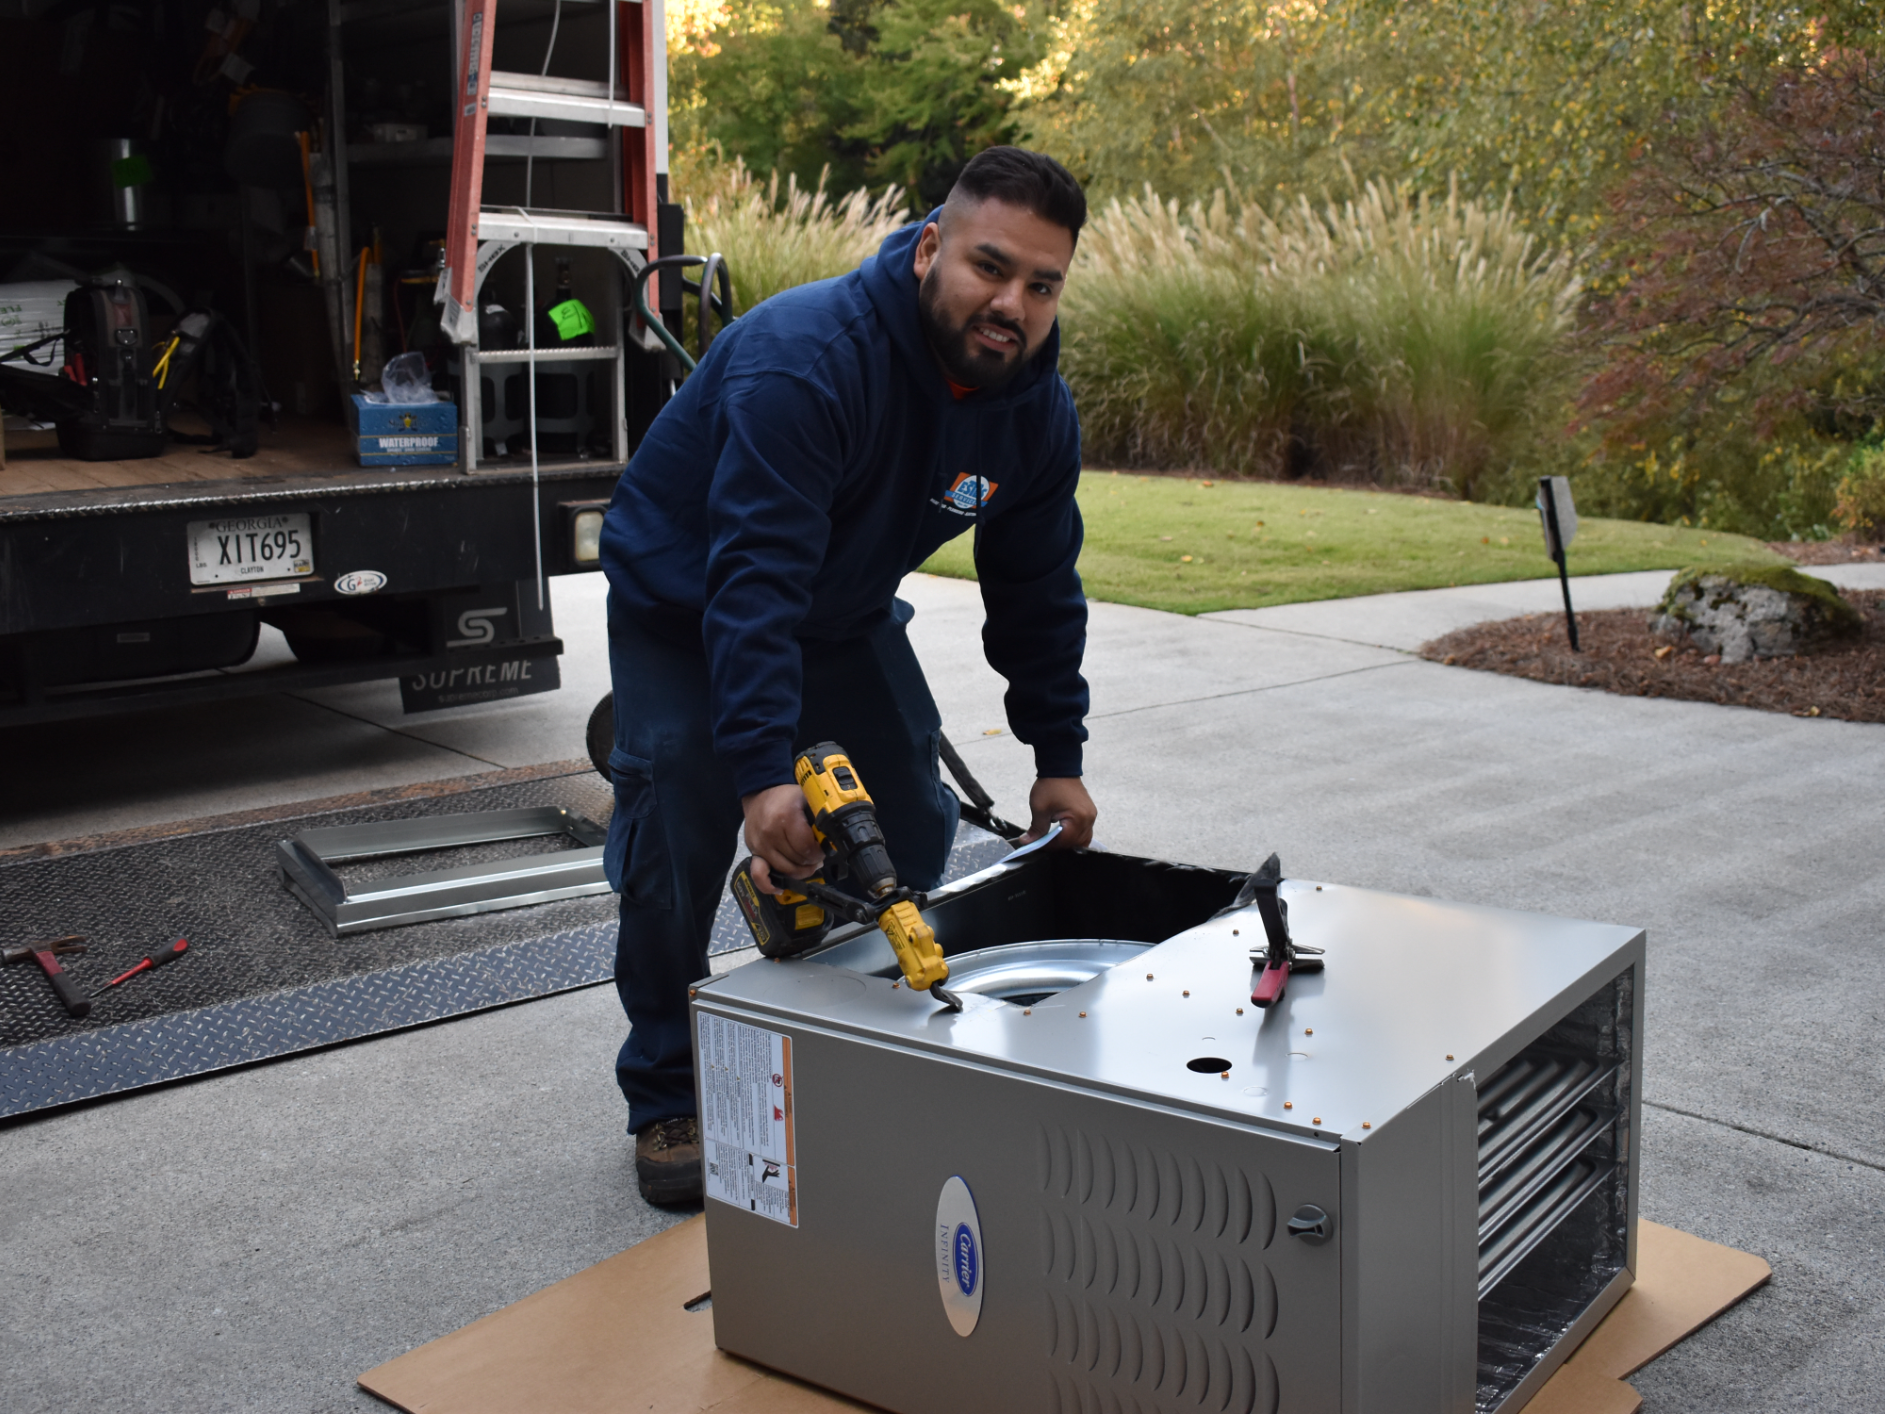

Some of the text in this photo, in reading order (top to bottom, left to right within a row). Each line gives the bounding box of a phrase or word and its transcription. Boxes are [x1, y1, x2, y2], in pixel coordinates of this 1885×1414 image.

[378, 436, 439, 449] WATERPROOF
[216, 517, 283, 533] GEORGIA
[217, 529, 301, 565] XIT695
[240, 566, 265, 575] CLAYTON
[940, 1223, 950, 1283] INFINITY
[960, 1233, 972, 1288] Carrier
